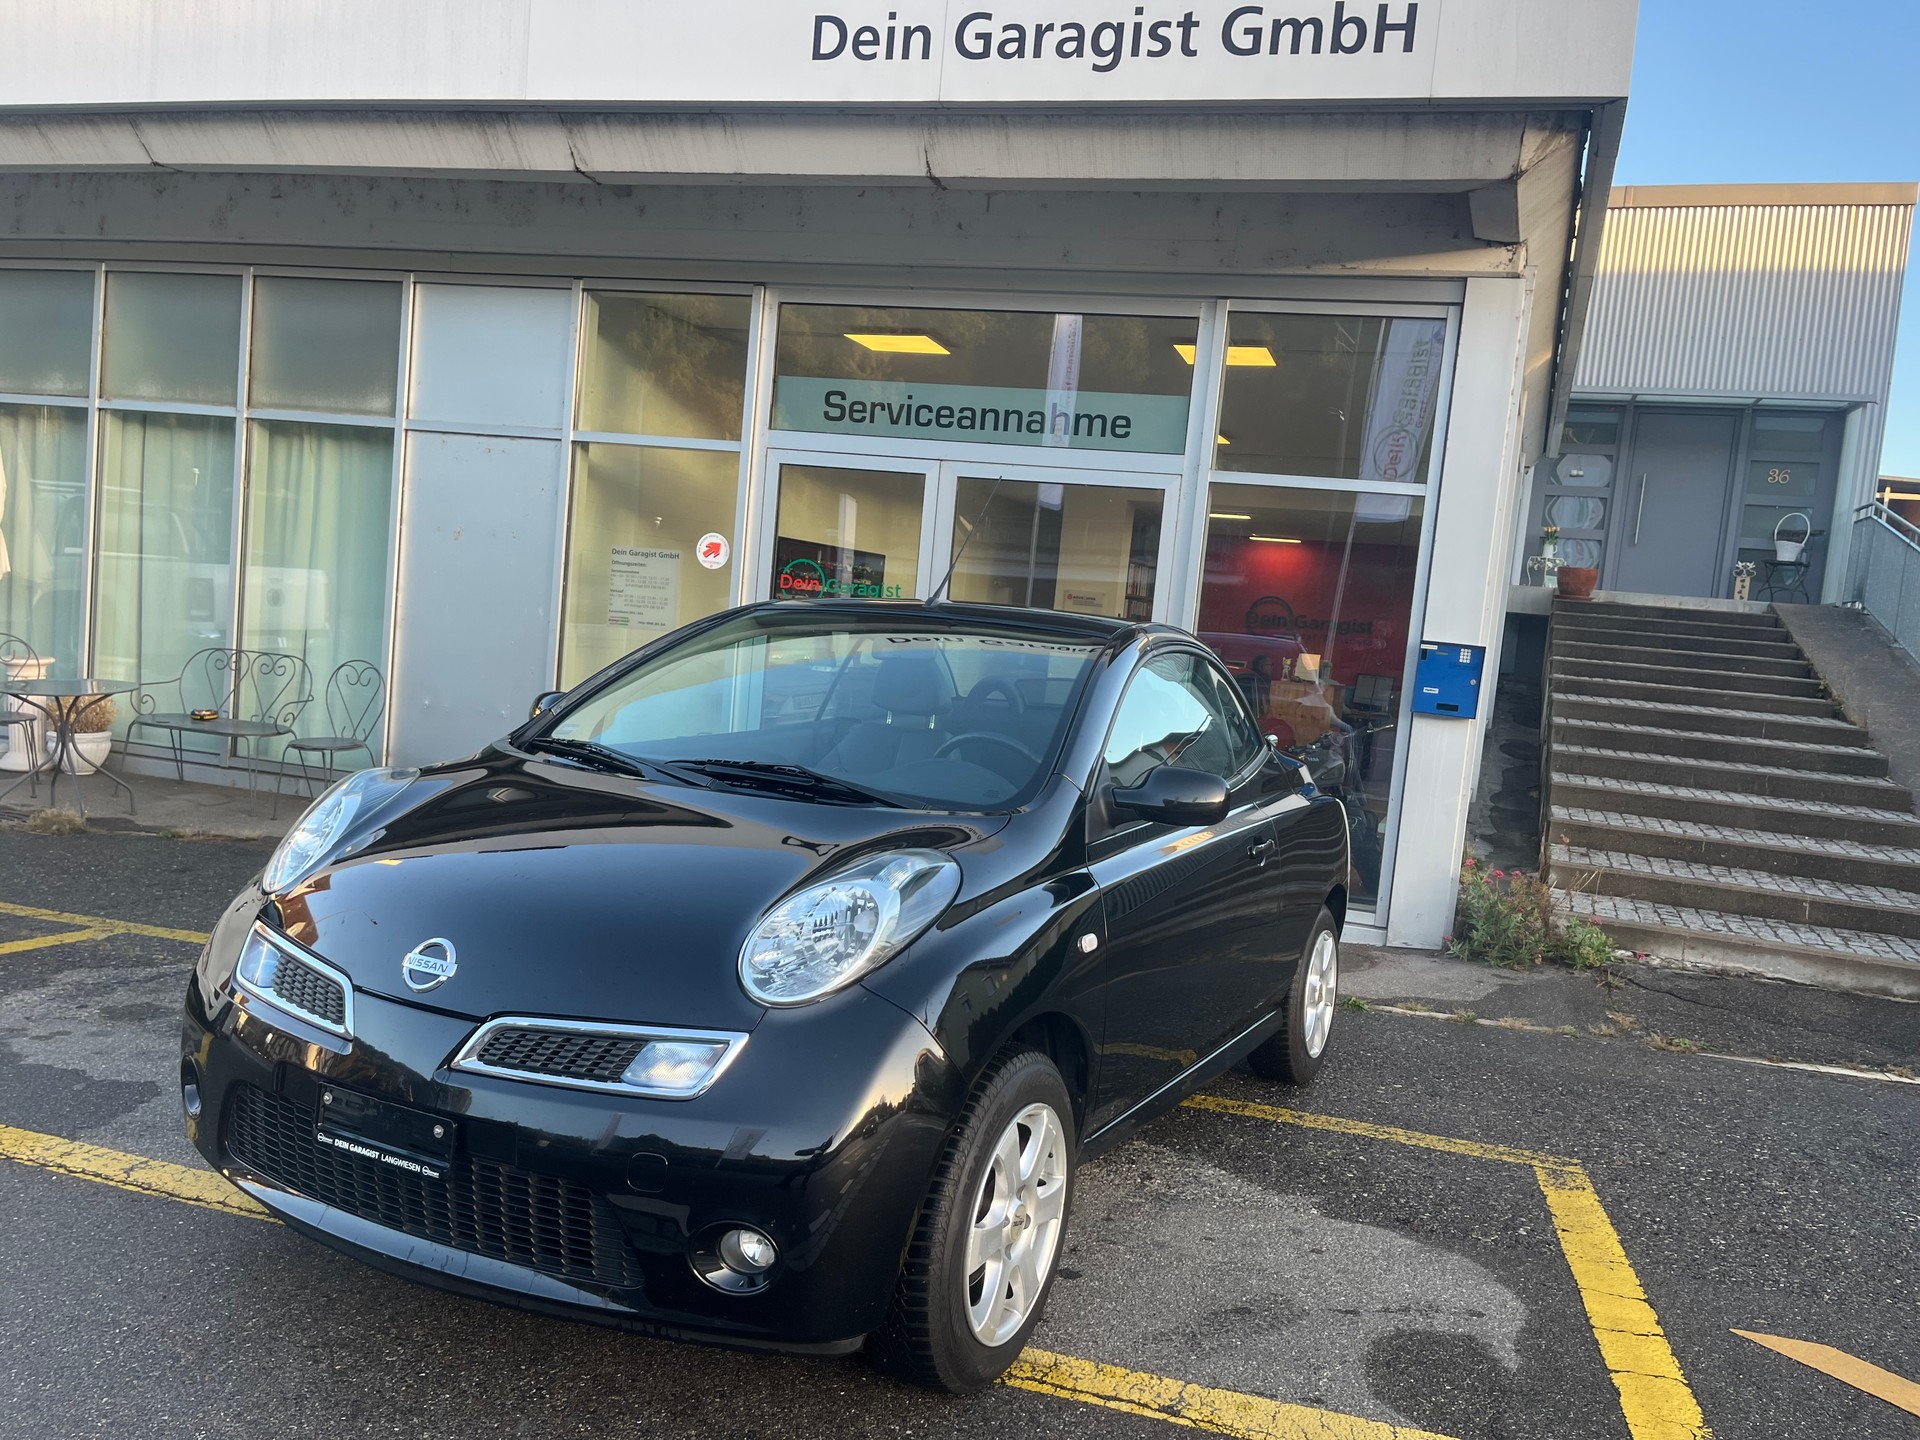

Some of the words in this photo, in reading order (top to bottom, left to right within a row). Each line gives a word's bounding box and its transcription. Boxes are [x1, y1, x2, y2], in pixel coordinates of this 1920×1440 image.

[811, 12, 932, 61] Dein
[954, 6, 1200, 72] Garagist
[1221, 0, 1418, 56] GmbH
[823, 390, 1132, 439] Serviceannahme
[1767, 468, 1791, 484] 36
[611, 547, 627, 556] Dein
[628, 549, 657, 559] Garagist
[658, 551, 680, 560] GmbH
[780, 574, 820, 592] Dein
[826, 578, 902, 598] Garagist
[406, 956, 448, 973] NISSAN
[334, 1138, 349, 1150] DEIN
[349, 1143, 380, 1160] GARAGIST
[381, 1153, 421, 1173] LANGWIESEN
